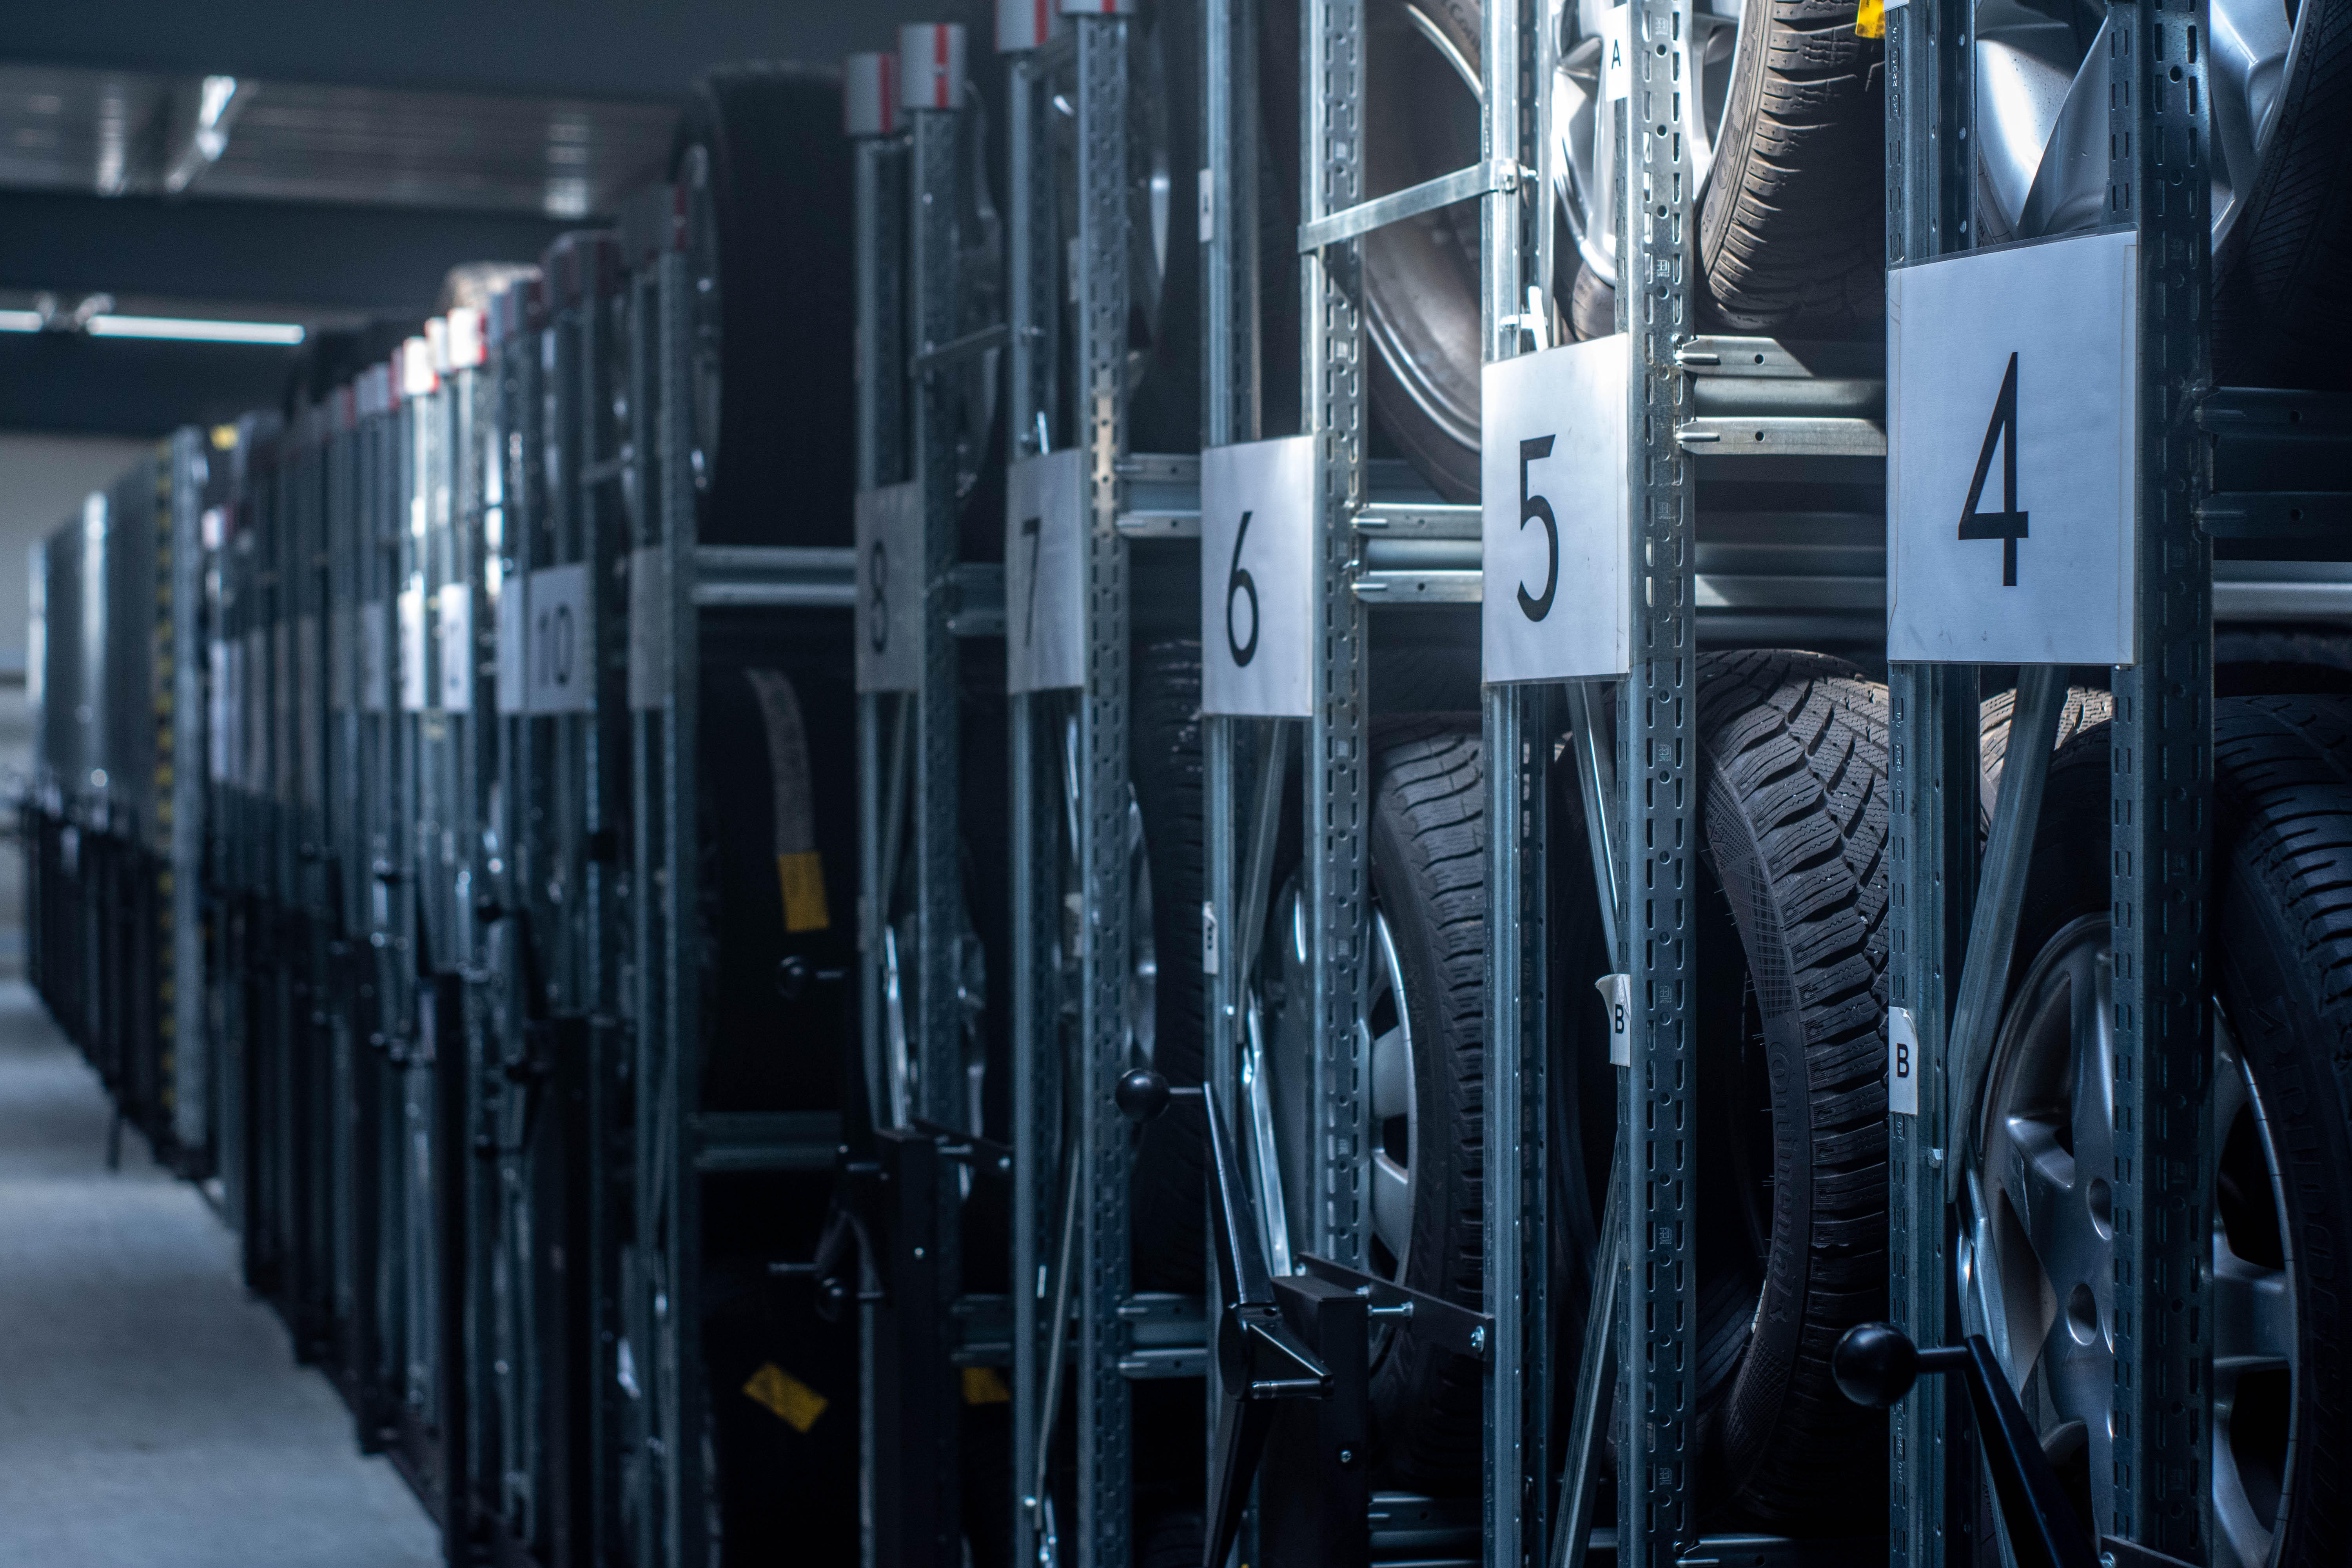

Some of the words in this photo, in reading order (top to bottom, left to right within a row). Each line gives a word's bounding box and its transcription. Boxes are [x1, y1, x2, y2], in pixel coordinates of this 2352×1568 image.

[1611, 40, 1621, 69] A
[1517, 434, 1559, 622] 5
[1958, 352, 2029, 586] 4
[870, 540, 888, 655] 8
[1022, 517, 1041, 647] 7
[1226, 511, 1259, 668] 6
[1614, 1004, 1624, 1034] B
[1896, 1043, 1909, 1078] B
[1768, 1041, 1797, 1297] Continental
